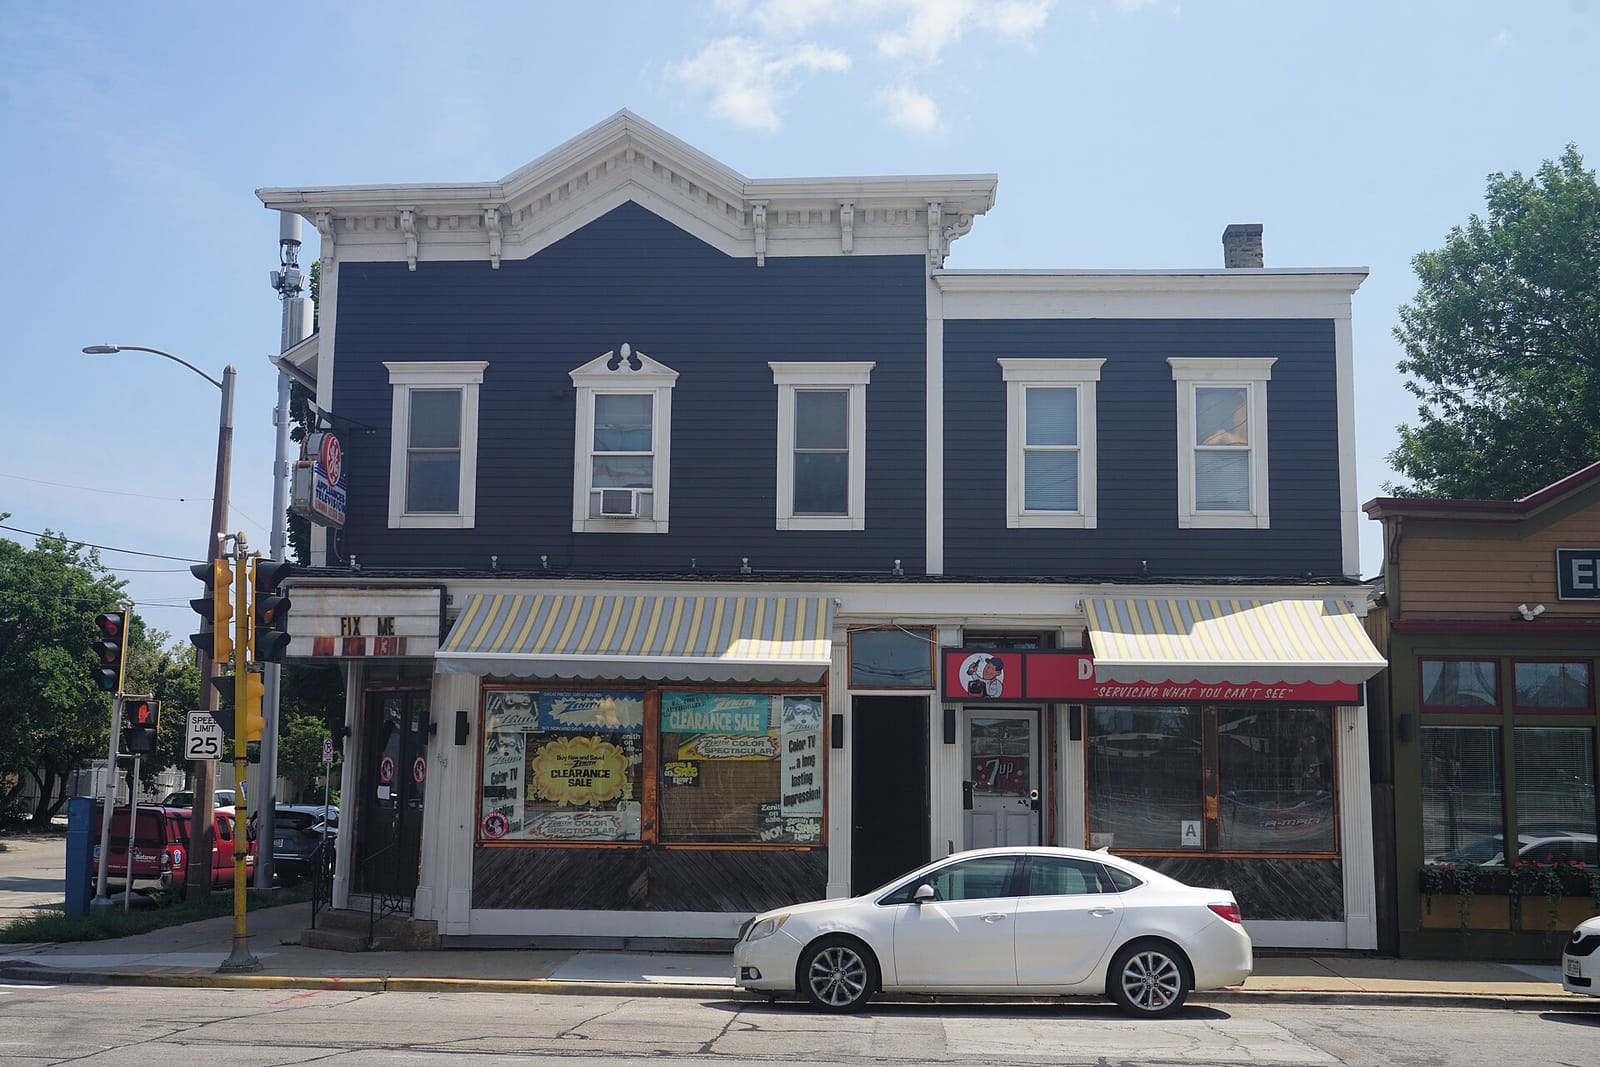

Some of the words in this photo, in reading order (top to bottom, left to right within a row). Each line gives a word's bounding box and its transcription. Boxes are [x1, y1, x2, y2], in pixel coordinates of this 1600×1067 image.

[317, 480, 345, 504] APPLIANCES
[316, 489, 346, 513] TELEVISION
[1571, 559, 1600, 590] E
[341, 616, 361, 636] FIX
[378, 617, 395, 636] ME
[1078, 658, 1094, 680] D
[1093, 686, 1159, 698] "SERVICING
[1162, 686, 1196, 698] WHAT
[1199, 687, 1222, 698] YOU
[1224, 687, 1262, 699] CAN'T
[1264, 688, 1294, 699] SEE"
[194, 725, 215, 733] LIMIT
[669, 711, 732, 730] CLEARANCE
[734, 713, 760, 731] SALE
[622, 732, 641, 740] enith
[789, 738, 806, 753] Color
[807, 734, 816, 749] TV
[190, 737, 218, 754] 25
[801, 754, 816, 768] long
[490, 770, 508, 785] Color
[510, 767, 518, 781] TV
[551, 769, 611, 778] CLEARANCE
[791, 771, 813, 787] lasting
[568, 778, 593, 787] SALE
[783, 786, 821, 807] impression!
[760, 803, 781, 811] Zenit
[1185, 823, 1197, 837] A
